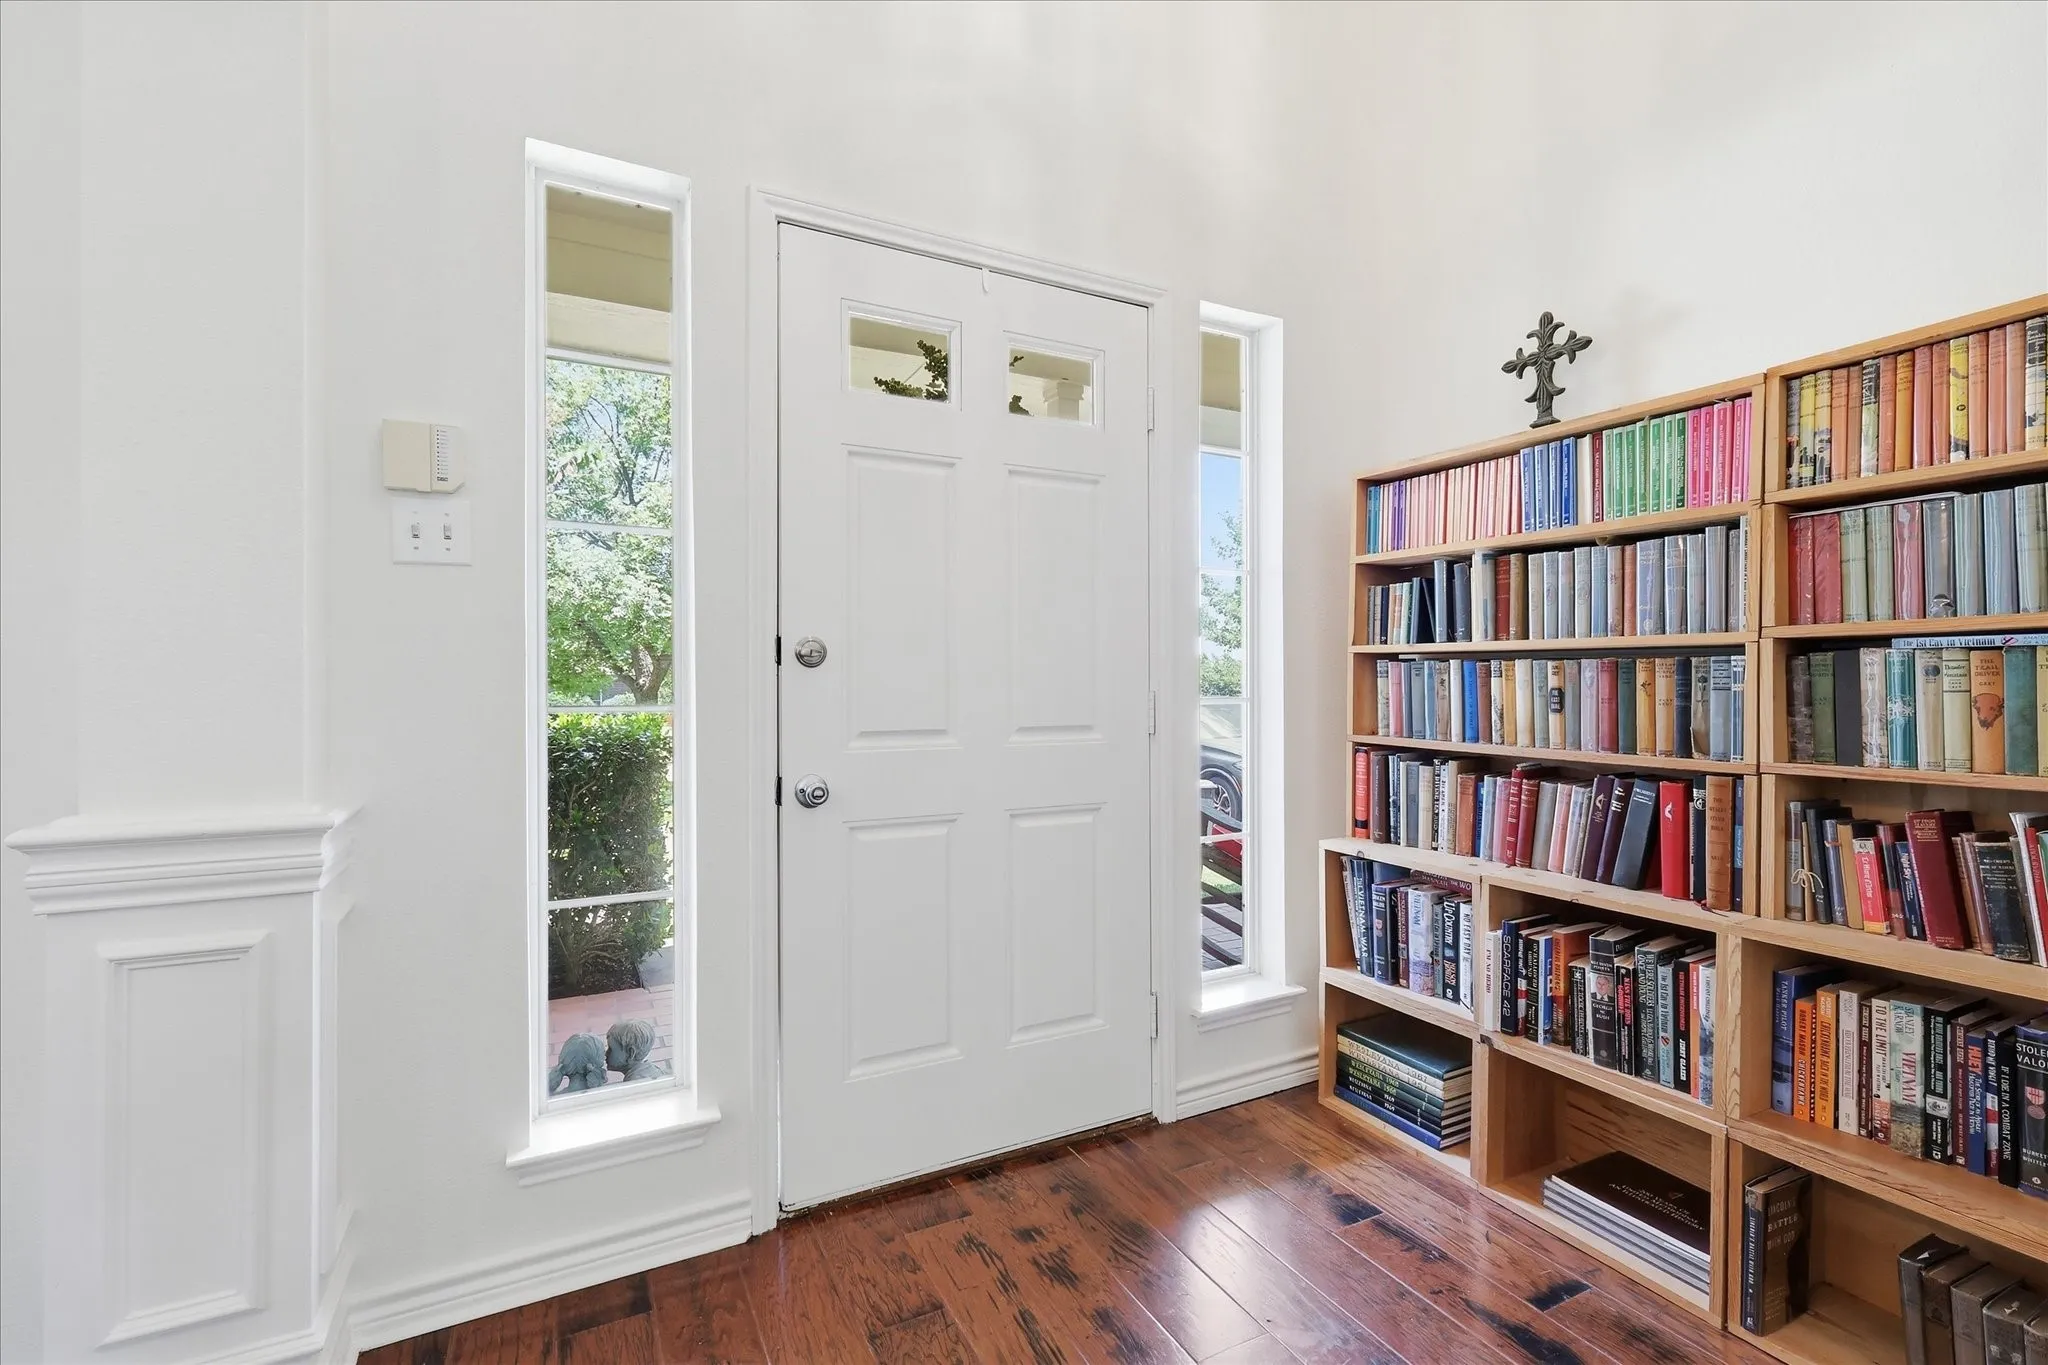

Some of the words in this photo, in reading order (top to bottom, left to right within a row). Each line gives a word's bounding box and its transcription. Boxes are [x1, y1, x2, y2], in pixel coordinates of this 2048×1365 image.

[1958, 637, 1996, 646] Vietnam
[1463, 913, 1470, 922] NO
[1503, 935, 1511, 997] SCARFACE
[1646, 981, 1654, 1007] SOLDIERS
[1502, 1000, 1511, 1017] 42
[1875, 1005, 1886, 1016] TO
[1893, 1005, 1904, 1034] KARNOW
[1661, 1010, 1669, 1033] Vietnam
[1875, 1018, 1886, 1032] THE
[1905, 1006, 1915, 1036] STANLEY
[1348, 1040, 1400, 1070] WESLEYANA
[1875, 1034, 1887, 1057] LIMIT
[1348, 1049, 1399, 1078] WESLEYANA
[1968, 1045, 1982, 1075] HUEY
[2016, 1054, 2048, 1068] VALO
[1798, 1059, 1806, 1106] CHICKENHAWK
[1902, 1051, 1916, 1104] VIETNAM
[2001, 1079, 2010, 1091] DIE
[2002, 1092, 2010, 1100] IN
[2002, 1109, 2010, 1139] COMBAT
[2002, 1140, 2011, 1160] ZONE
[1767, 1213, 1798, 1232] BATTLE
